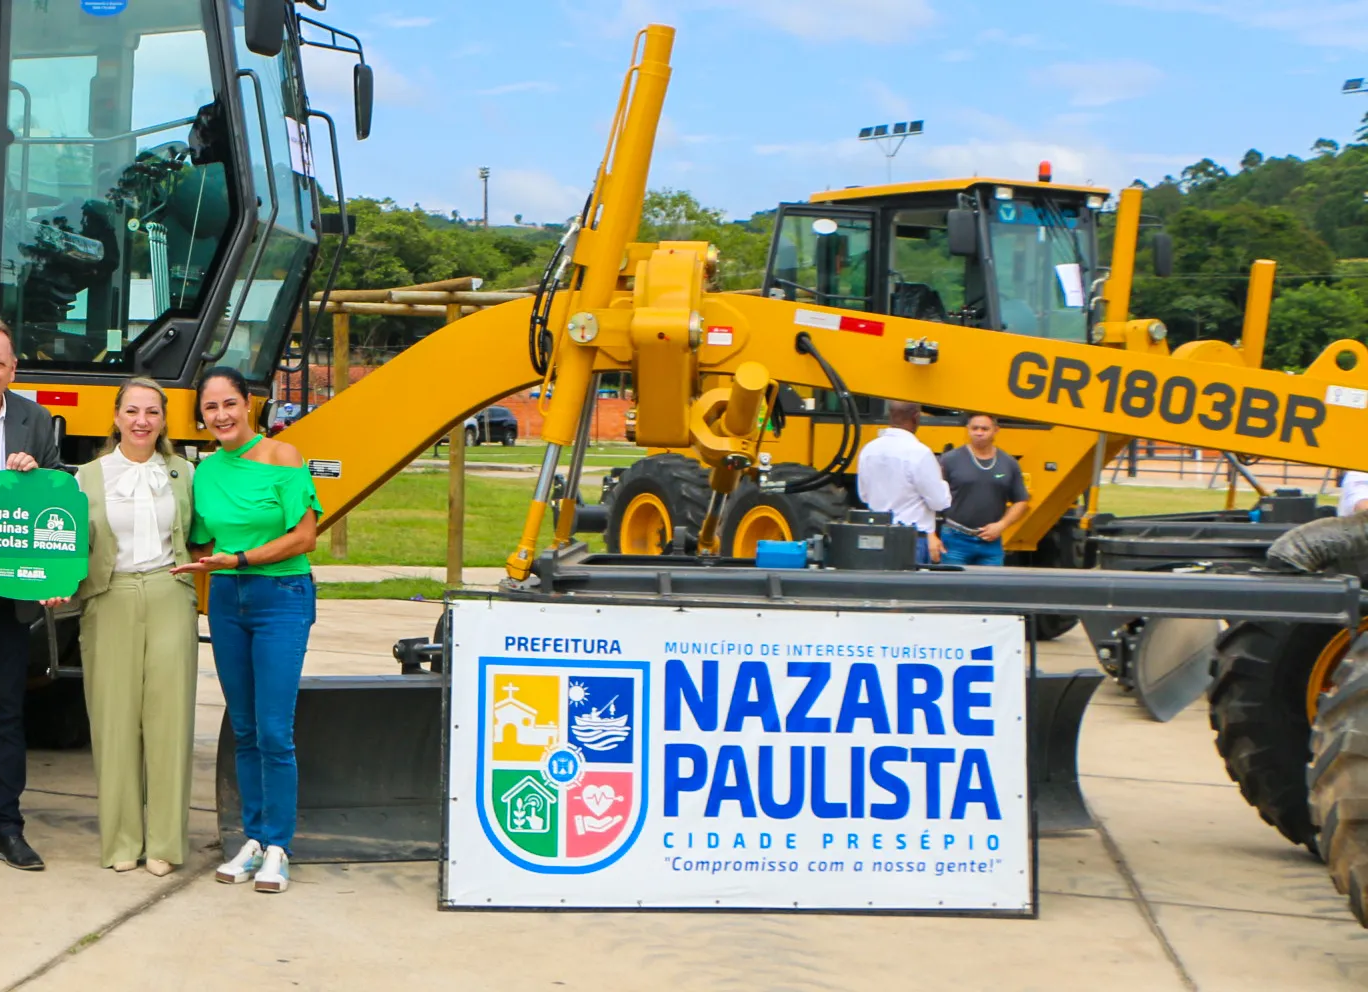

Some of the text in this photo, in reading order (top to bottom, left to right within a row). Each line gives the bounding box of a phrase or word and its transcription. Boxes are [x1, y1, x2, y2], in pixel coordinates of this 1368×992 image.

[1007, 351, 1327, 448] GR1803BR
[12, 507, 30, 520] de
[33, 540, 76, 552] PROMAQ
[504, 635, 622, 655] PREFEITURA
[664, 640, 965, 660] MUNICÍPIO DE INTERESSE TURÍSTICO
[664, 645, 995, 737] NAZARÉ
[663, 743, 1002, 821] PAULISTA
[663, 829, 1000, 851] CIDADE PRESÉPIO
[664, 856, 1002, 877] "Compromisso com a nossa gente!"
